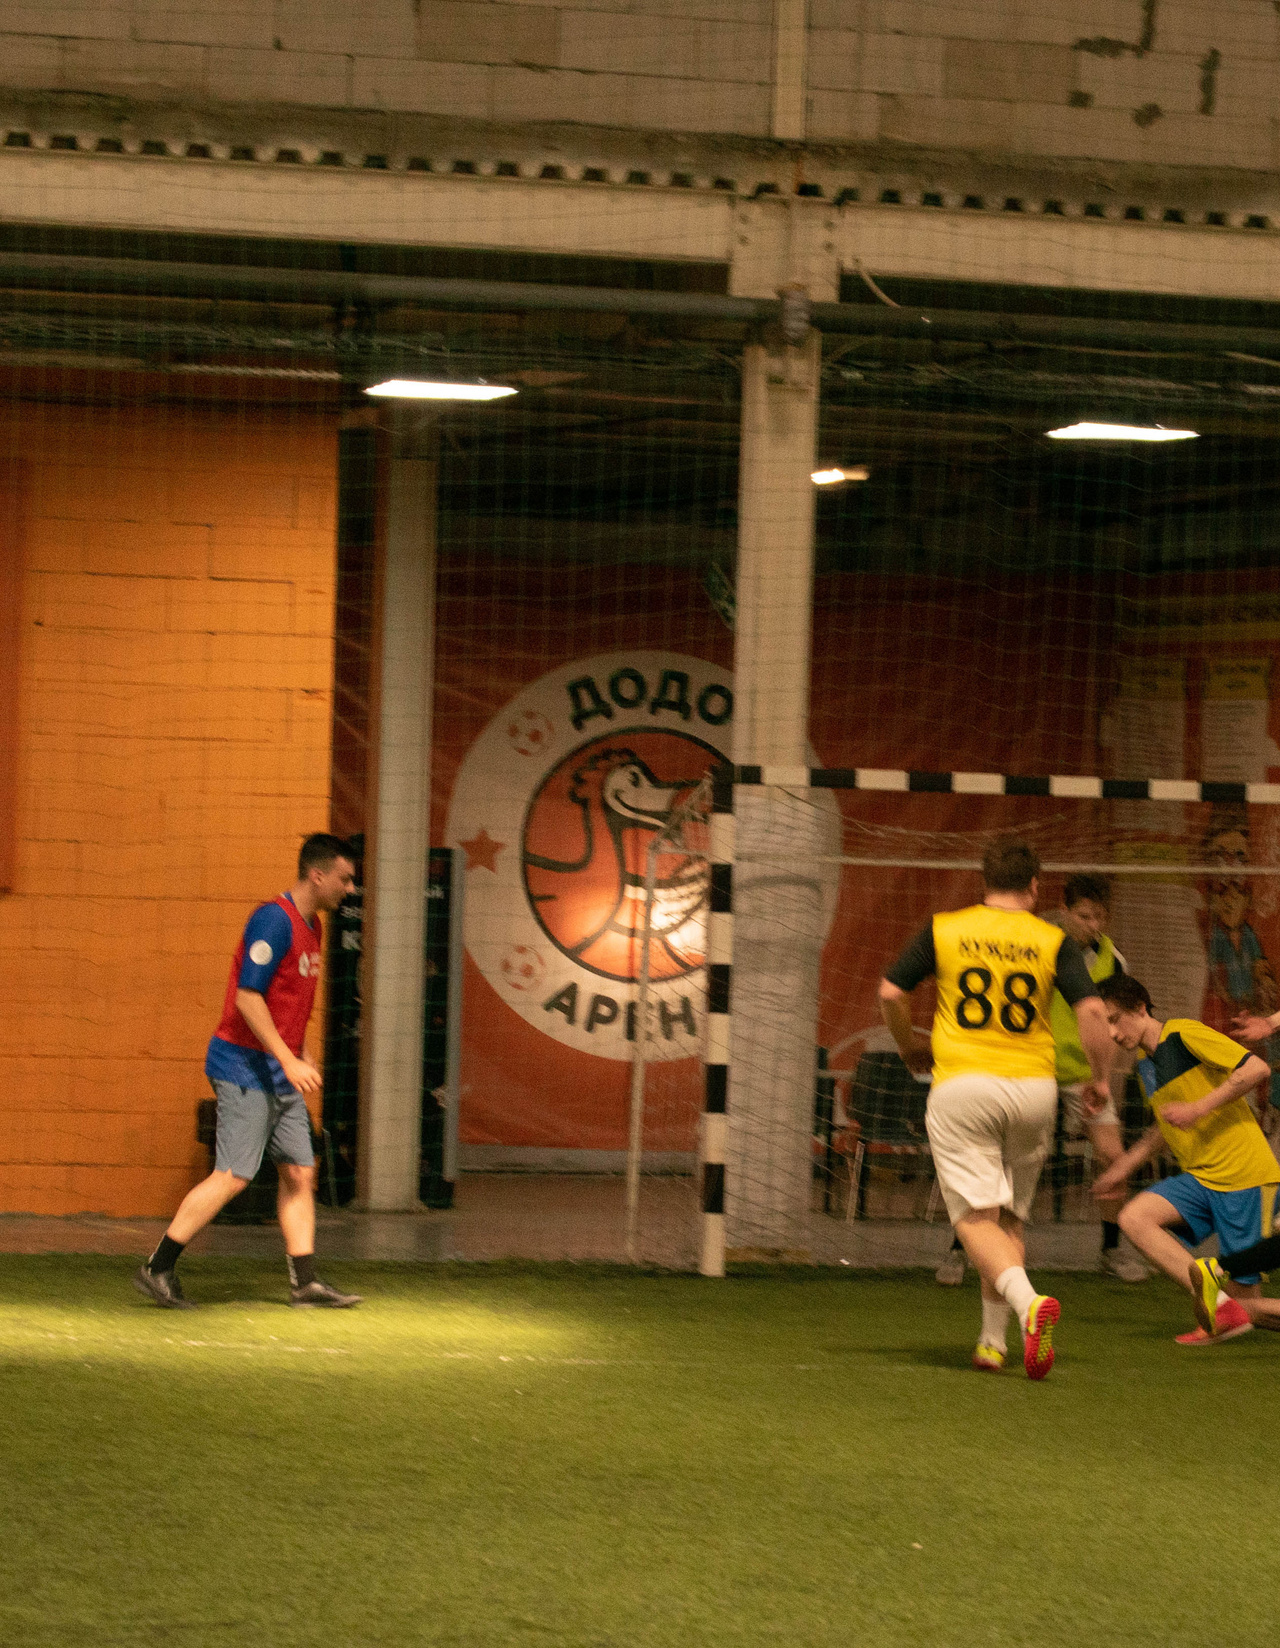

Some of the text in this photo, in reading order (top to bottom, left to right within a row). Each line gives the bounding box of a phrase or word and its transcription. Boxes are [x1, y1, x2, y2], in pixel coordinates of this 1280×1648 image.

[566, 667, 734, 731] ДОДО
[542, 981, 697, 1042] АРЕН
[956, 967, 1037, 1033] 88
